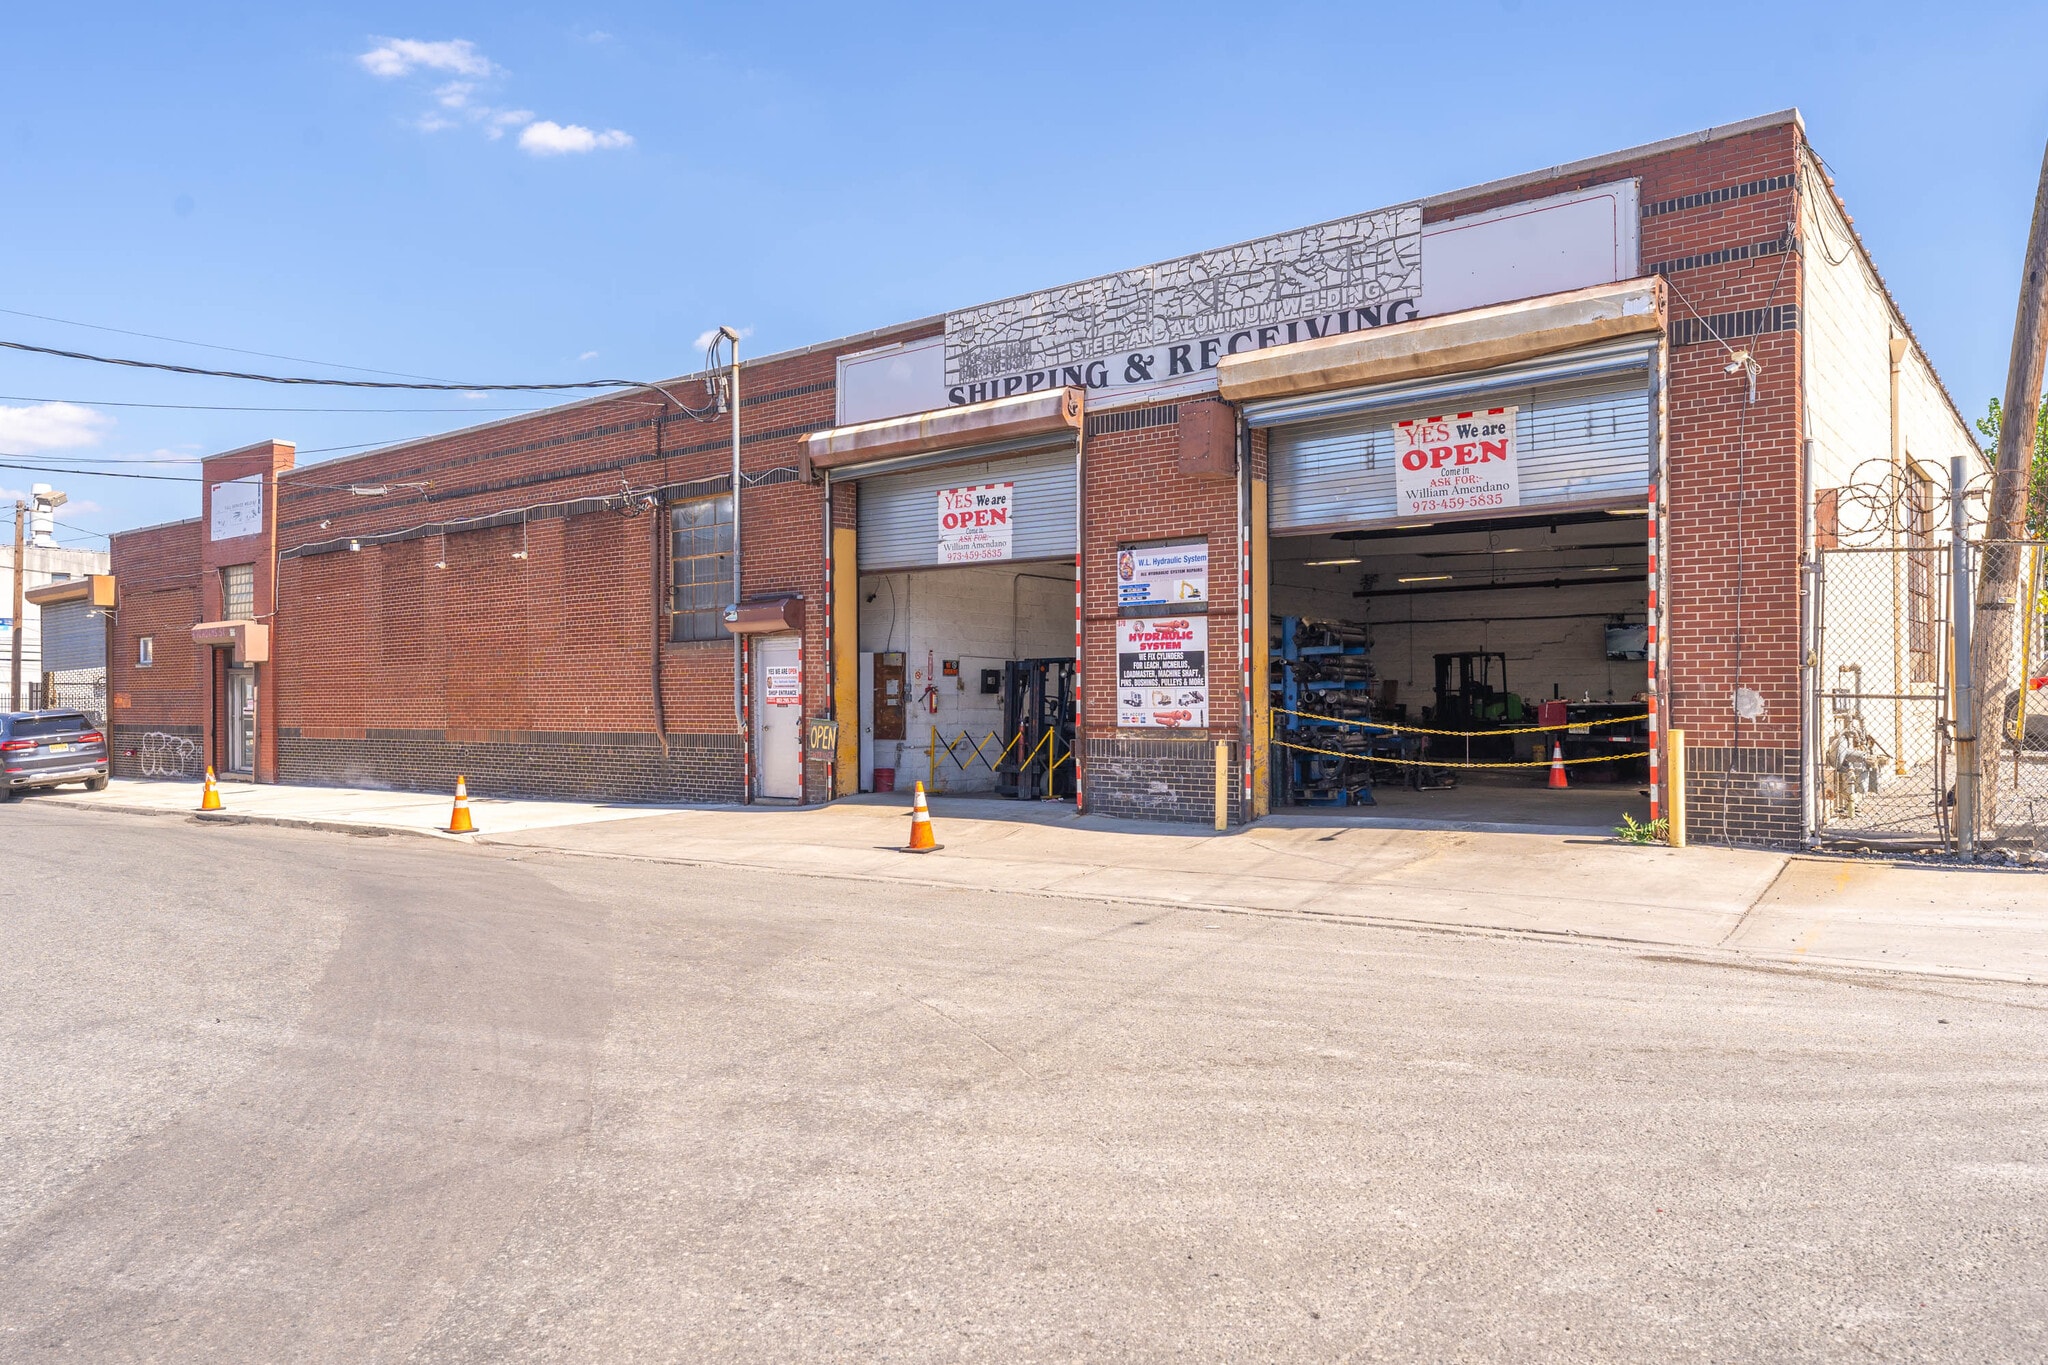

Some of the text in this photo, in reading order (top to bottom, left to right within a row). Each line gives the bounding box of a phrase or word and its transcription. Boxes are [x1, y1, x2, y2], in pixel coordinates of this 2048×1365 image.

[1072, 335, 1124, 359] STEEL
[1129, 324, 1167, 346] AND
[1170, 303, 1278, 336] ALUMINUM
[1282, 280, 1381, 316] WELDING
[948, 299, 1420, 405] SHIPPING & RECEIVING
[1405, 423, 1506, 446] YES We are
[1402, 439, 1509, 471] OPEN
[1441, 466, 1470, 477] Come in
[1430, 477, 1451, 487] ASK
[1406, 482, 1510, 500] William Amendano
[945, 493, 1006, 509] YES We are
[1412, 493, 1503, 513] 973-459-5835
[942, 508, 1008, 530] OPEN
[965, 527, 979, 535] Come
[958, 535, 972, 543] ASK
[944, 540, 1007, 551] William Amendano
[947, 548, 1002, 562] 973-459-5835
[1138, 555, 1207, 567] W.L. Hydraulic System
[1129, 631, 1193, 642] HYDRAULIC
[1140, 641, 1181, 650] SYSTEM
[1156, 652, 1184, 660] CYLINDERS
[1158, 669, 1181, 677] MACHINE
[1161, 678, 1182, 686] PULLEYS
[1189, 678, 1204, 686] MORE
[811, 725, 836, 750] OPEN
